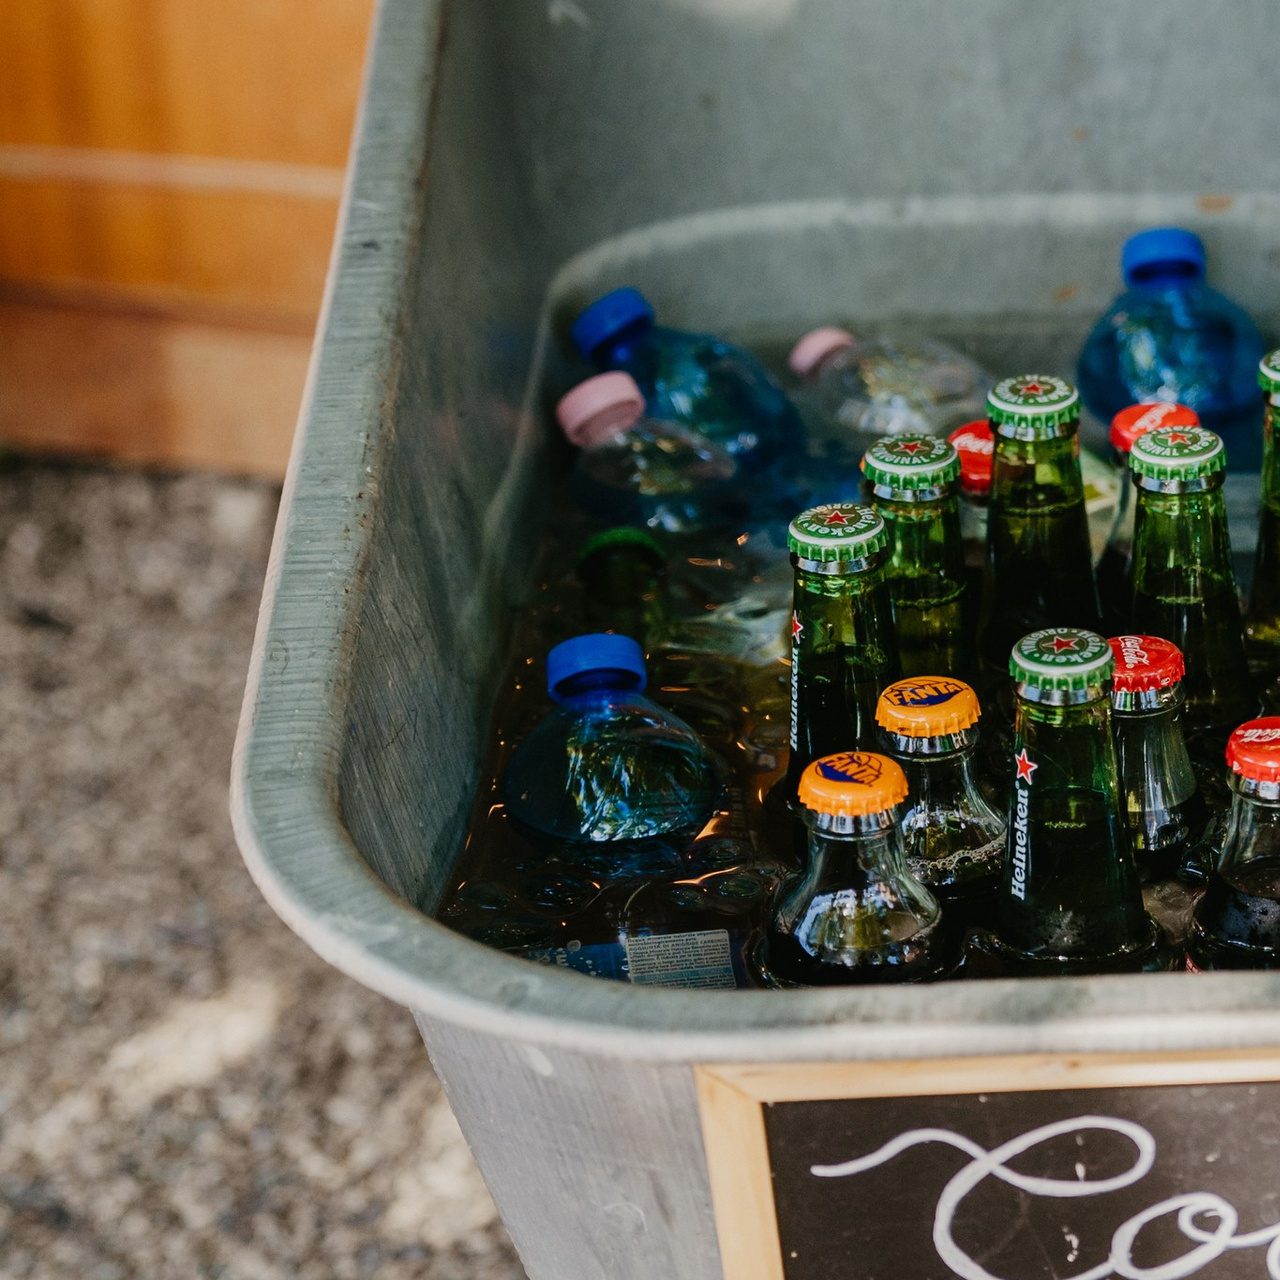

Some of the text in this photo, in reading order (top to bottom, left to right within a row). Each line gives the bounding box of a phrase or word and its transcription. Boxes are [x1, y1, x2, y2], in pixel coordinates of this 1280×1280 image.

[883, 681, 964, 707] FANTA
[818, 754, 881, 786] FANTA
[1011, 789, 1029, 901] Heineken
